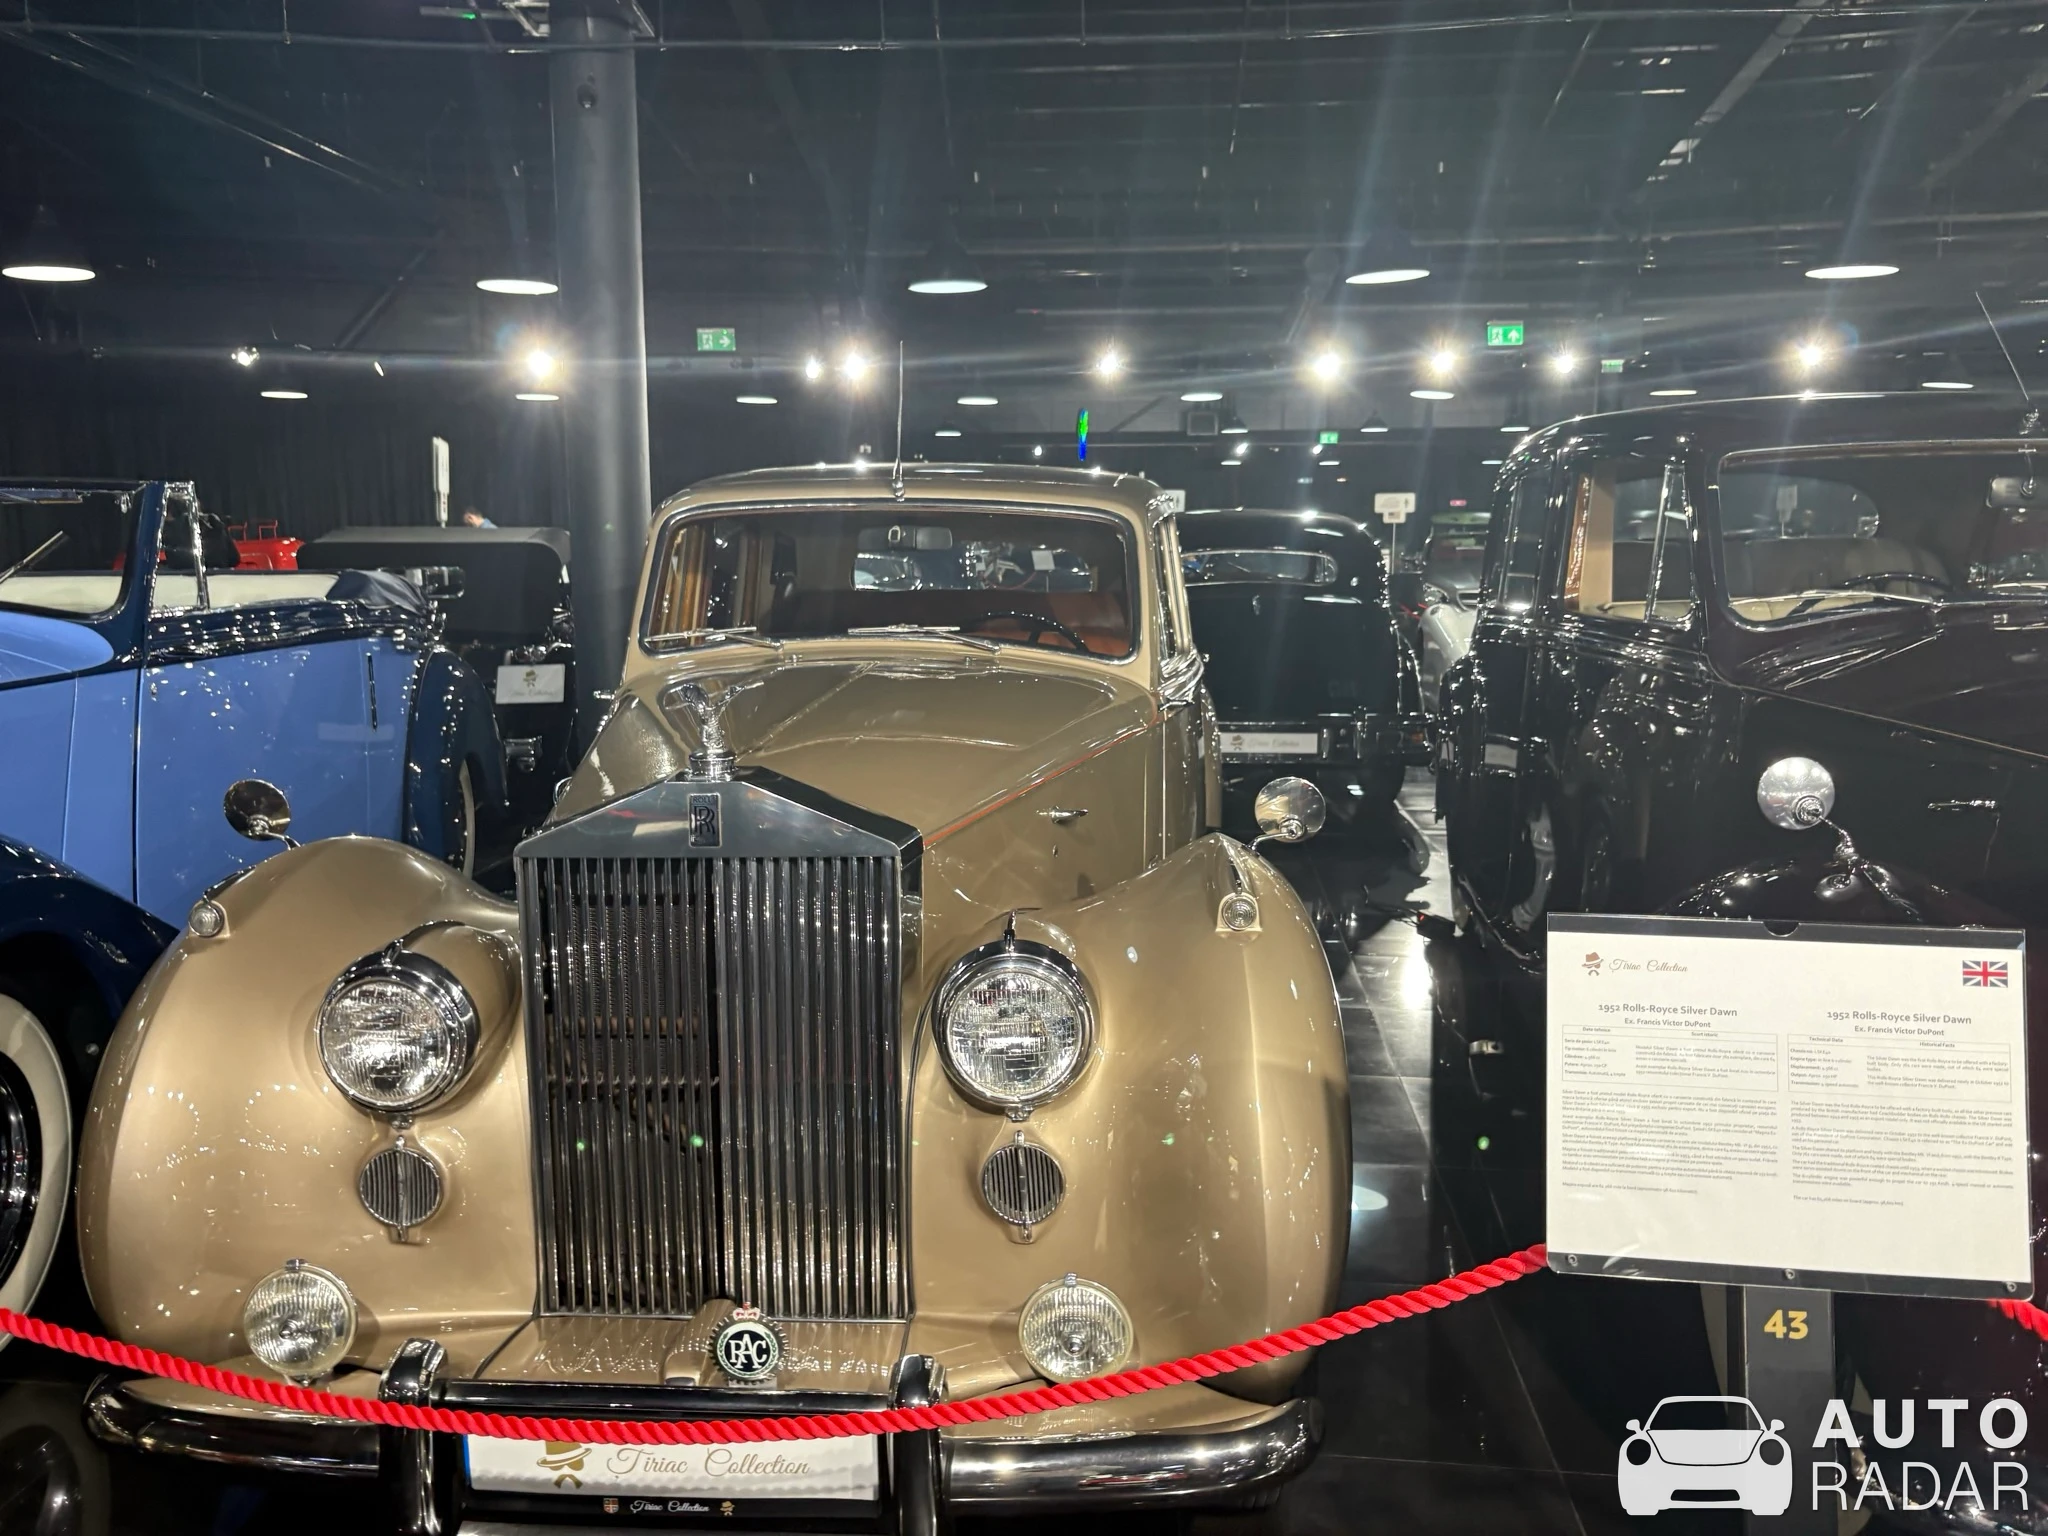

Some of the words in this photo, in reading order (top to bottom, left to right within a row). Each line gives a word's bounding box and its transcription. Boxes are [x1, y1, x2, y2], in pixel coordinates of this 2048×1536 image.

[1646, 960, 1688, 972] Collection
[1598, 1004, 1620, 1013] 1952
[1622, 1003, 1678, 1016] Rolls-Royce
[1680, 1006, 1708, 1015] Silver
[1710, 1007, 1738, 1016] Dawn
[1826, 1011, 1850, 1020] 1952
[1852, 1010, 1910, 1023] Rolls-Royce
[1912, 1013, 1940, 1022] Silver
[1943, 1015, 1972, 1024] Dawn
[1868, 1026, 1892, 1034] Francis
[1764, 1310, 1808, 1339] 43
[728, 1334, 768, 1368] RAC
[704, 1448, 810, 1476] Collection
[668, 1500, 710, 1512] Collection
